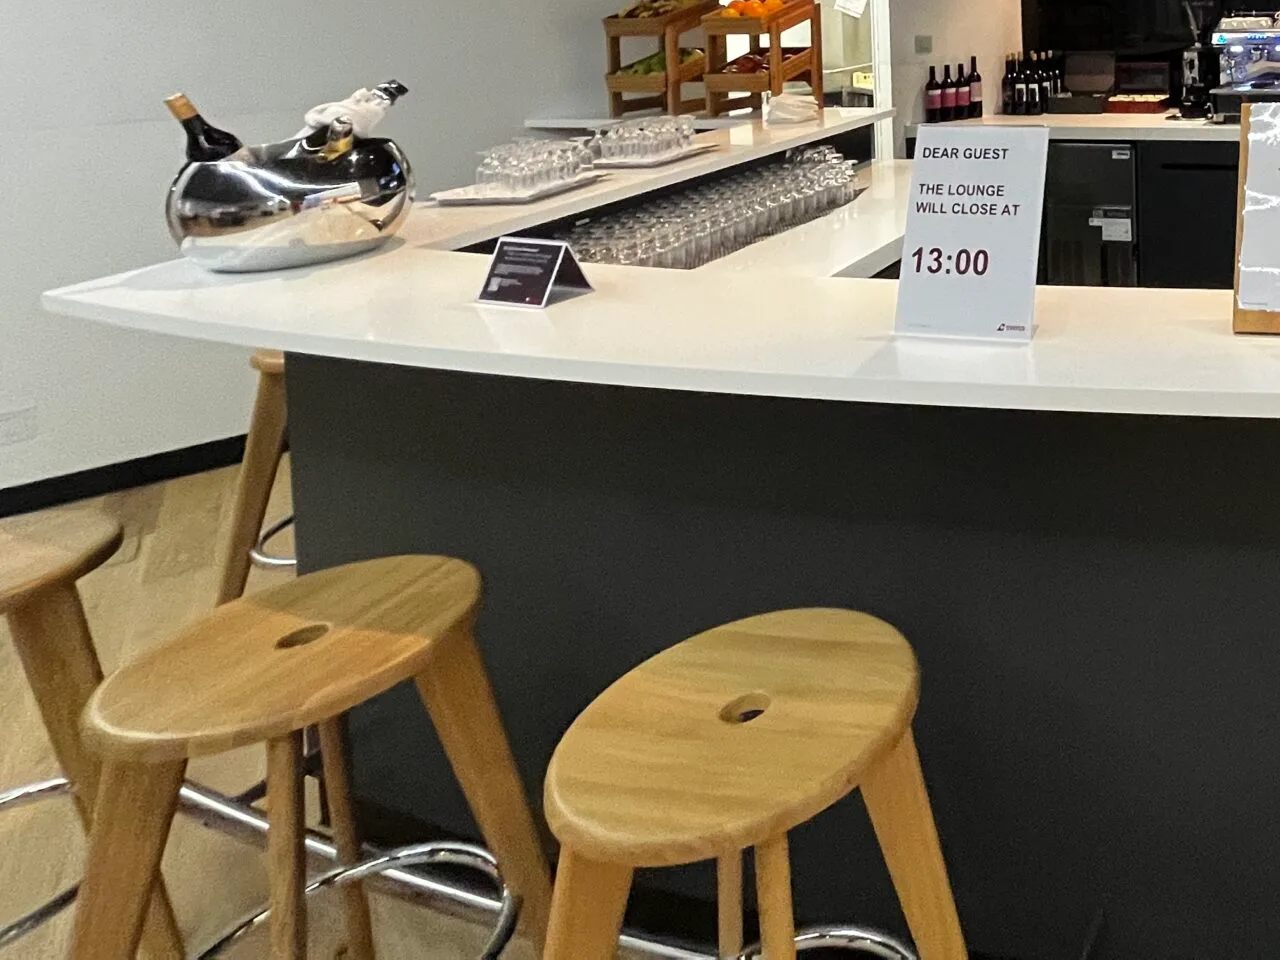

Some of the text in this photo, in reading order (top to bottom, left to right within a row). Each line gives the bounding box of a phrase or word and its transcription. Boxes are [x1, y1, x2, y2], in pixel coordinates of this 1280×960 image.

[922, 147, 1009, 160] DEAR GUEST
[918, 183, 1005, 197] THE LOUNGE
[915, 202, 1020, 216] WILL CLOSE AT
[912, 246, 989, 276] 13:00
